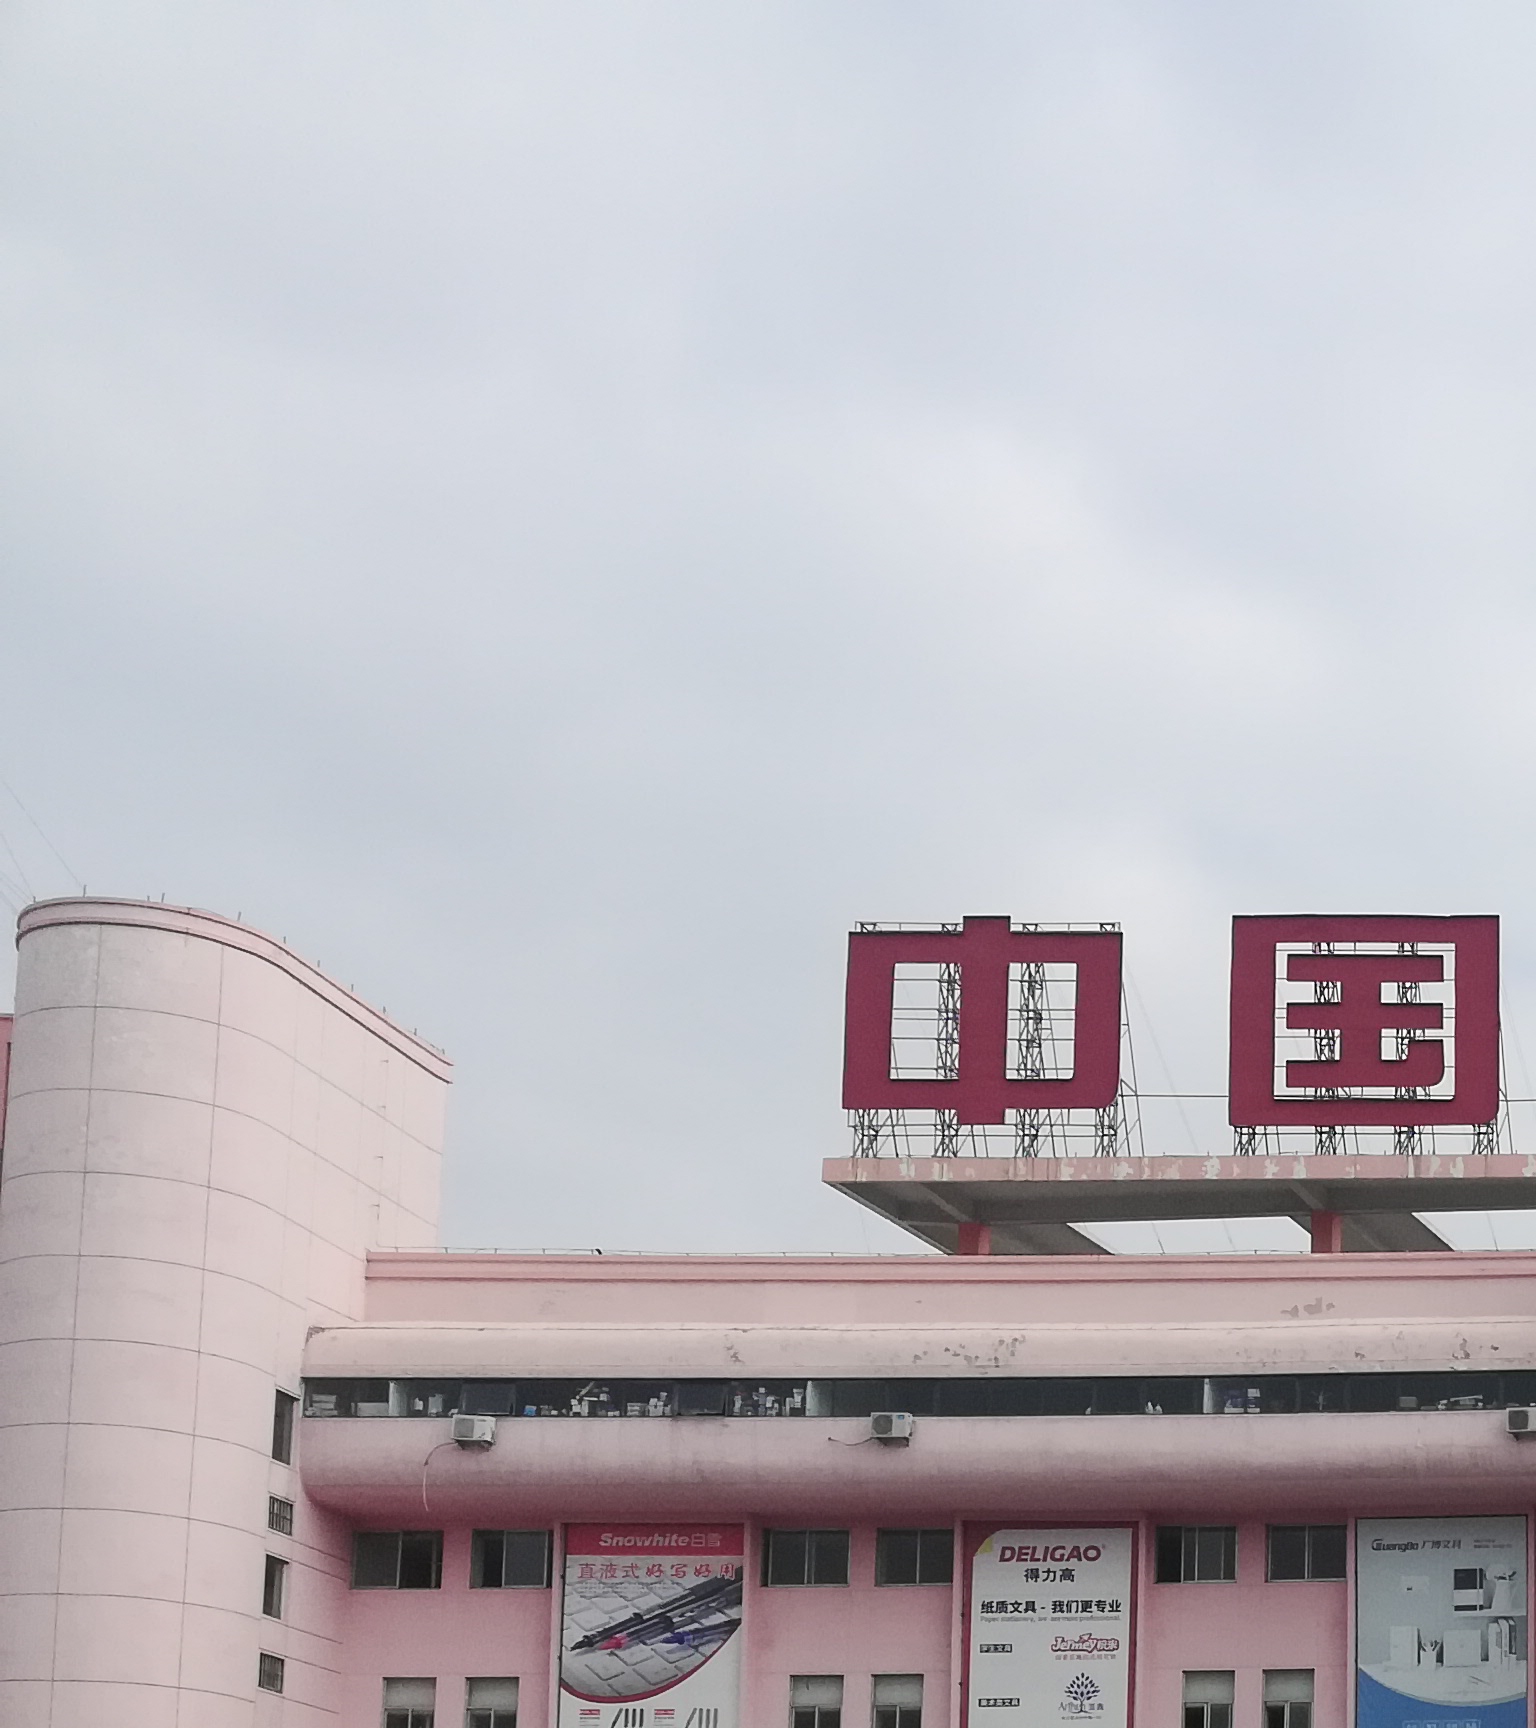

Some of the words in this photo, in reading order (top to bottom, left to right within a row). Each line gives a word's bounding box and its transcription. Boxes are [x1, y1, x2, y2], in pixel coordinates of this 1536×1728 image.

[999, 1544, 1102, 1563] DELIGAO
[577, 1562, 737, 1580] 直液式好写好用
[1023, 1567, 1076, 1583] 得力高
[980, 1600, 1037, 1614] 纸质文具
[1051, 1599, 1122, 1614] 我们更专业
